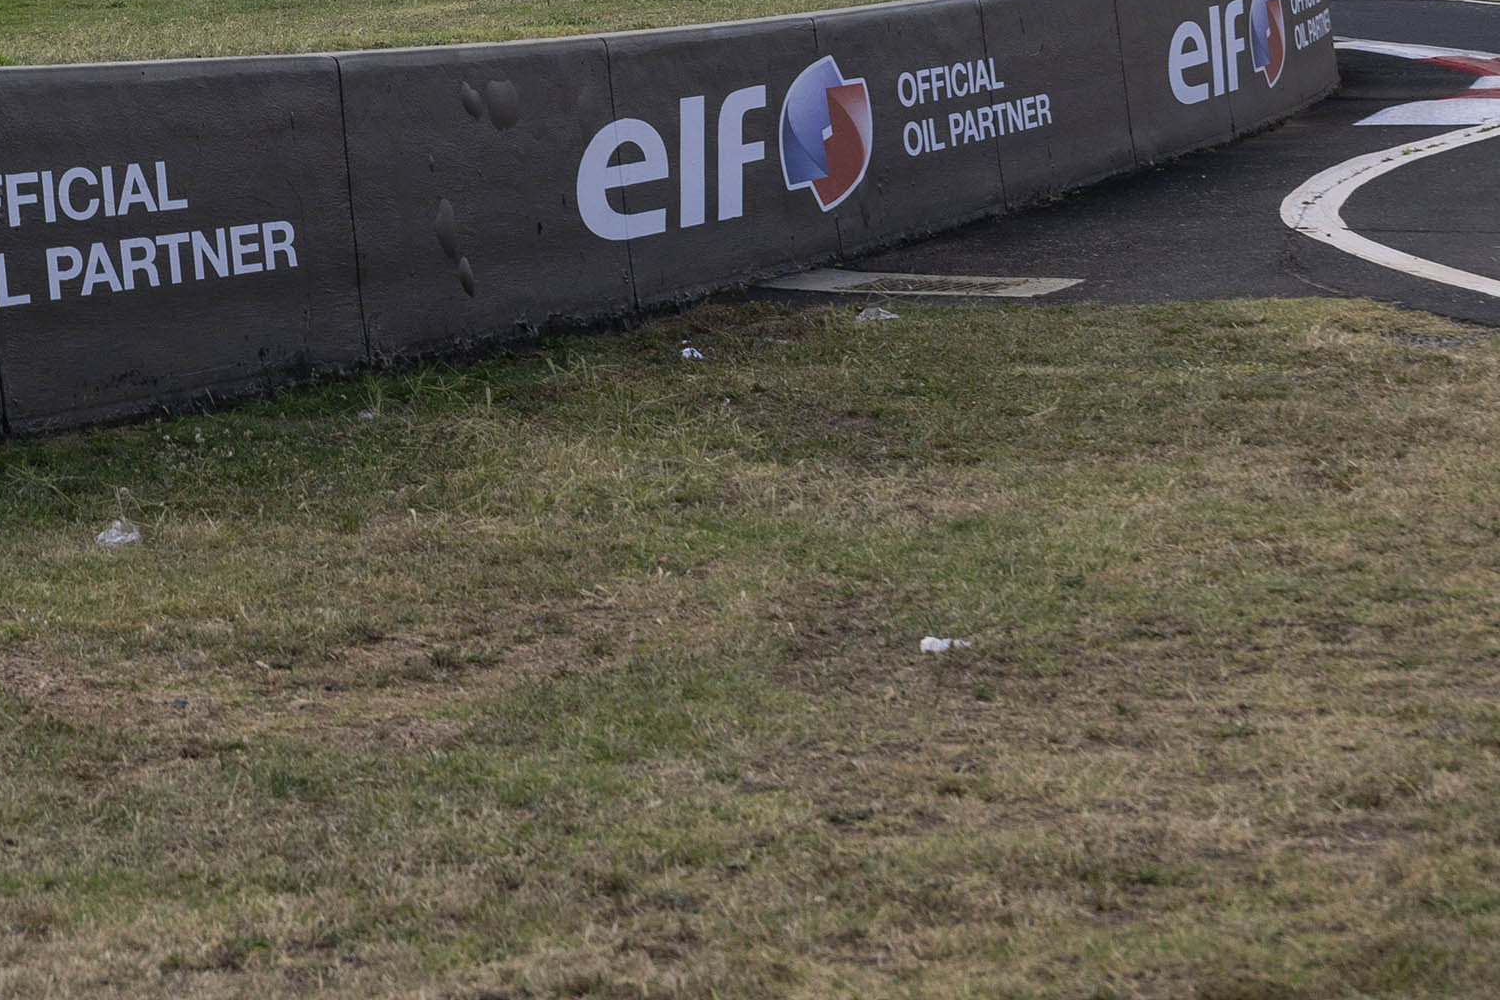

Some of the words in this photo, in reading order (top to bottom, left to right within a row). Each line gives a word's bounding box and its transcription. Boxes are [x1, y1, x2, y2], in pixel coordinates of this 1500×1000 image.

[1294, 23, 1309, 50] OIL
[1307, 7, 1332, 47] PARTNER
[897, 57, 1005, 109] OFFICIAL
[902, 117, 946, 157] OIL
[949, 93, 1053, 147] PARTNER
[577, 84, 767, 241] elf
[45, 220, 298, 301] PARTNER
